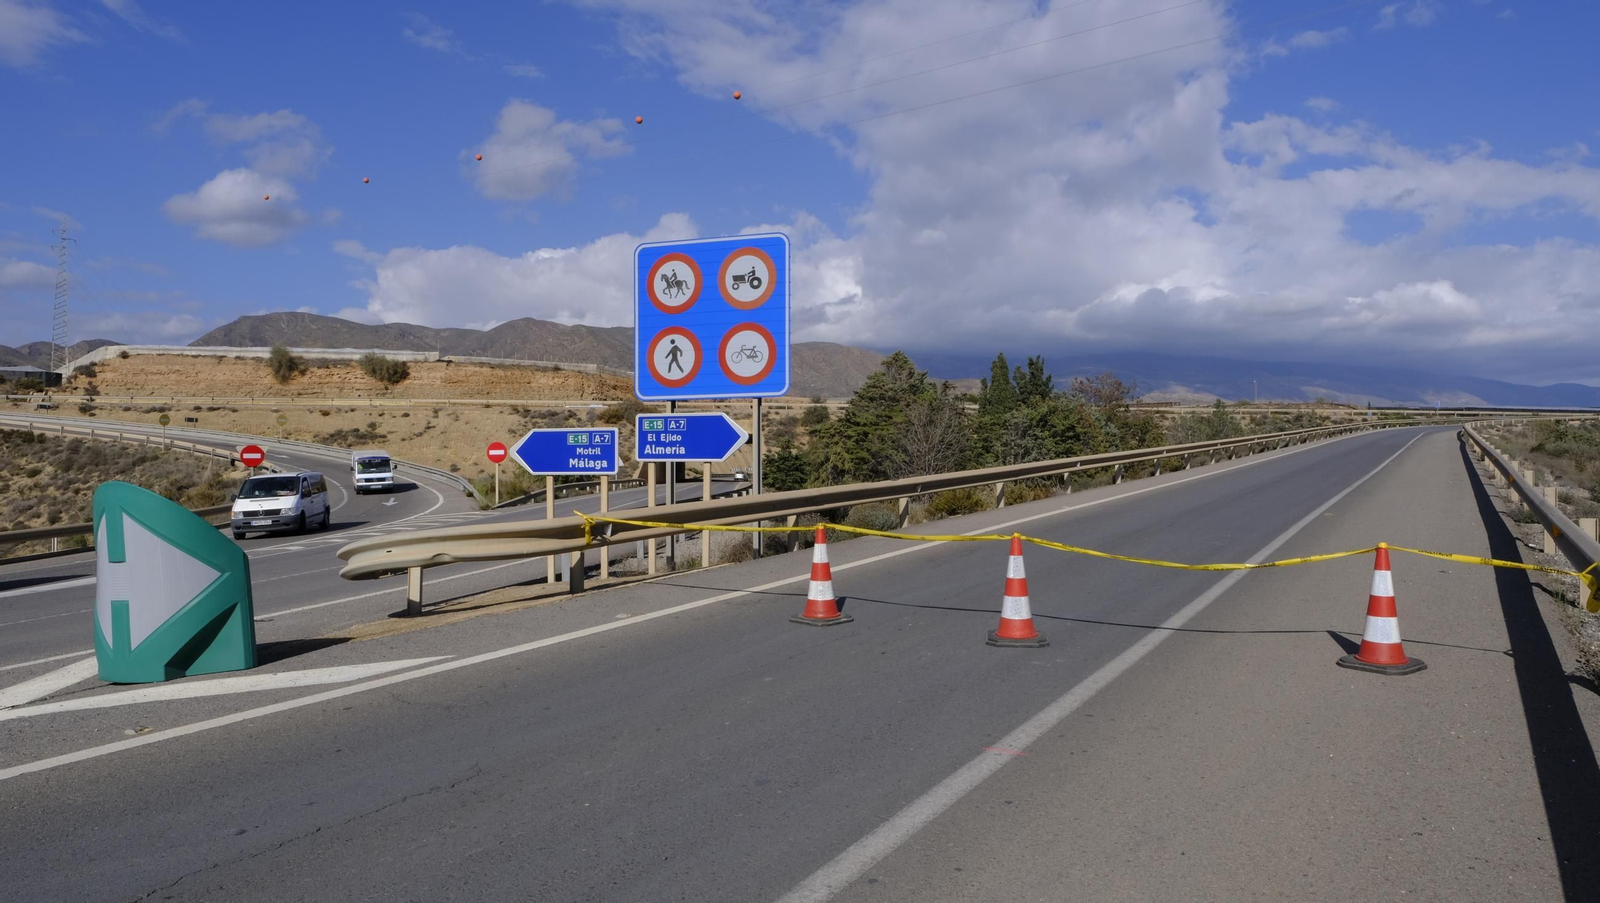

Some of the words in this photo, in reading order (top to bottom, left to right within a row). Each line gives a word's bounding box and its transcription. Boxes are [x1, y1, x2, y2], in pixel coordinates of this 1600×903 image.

[644, 420, 663, 429] E-15
[670, 420, 685, 428] A-7
[568, 435, 588, 443] E-15
[594, 434, 610, 442] A-7
[647, 434, 656, 442] El
[660, 434, 682, 442] Ejido
[576, 447, 601, 455] Motril
[644, 444, 686, 454] Almería
[569, 458, 608, 470] Málaga
